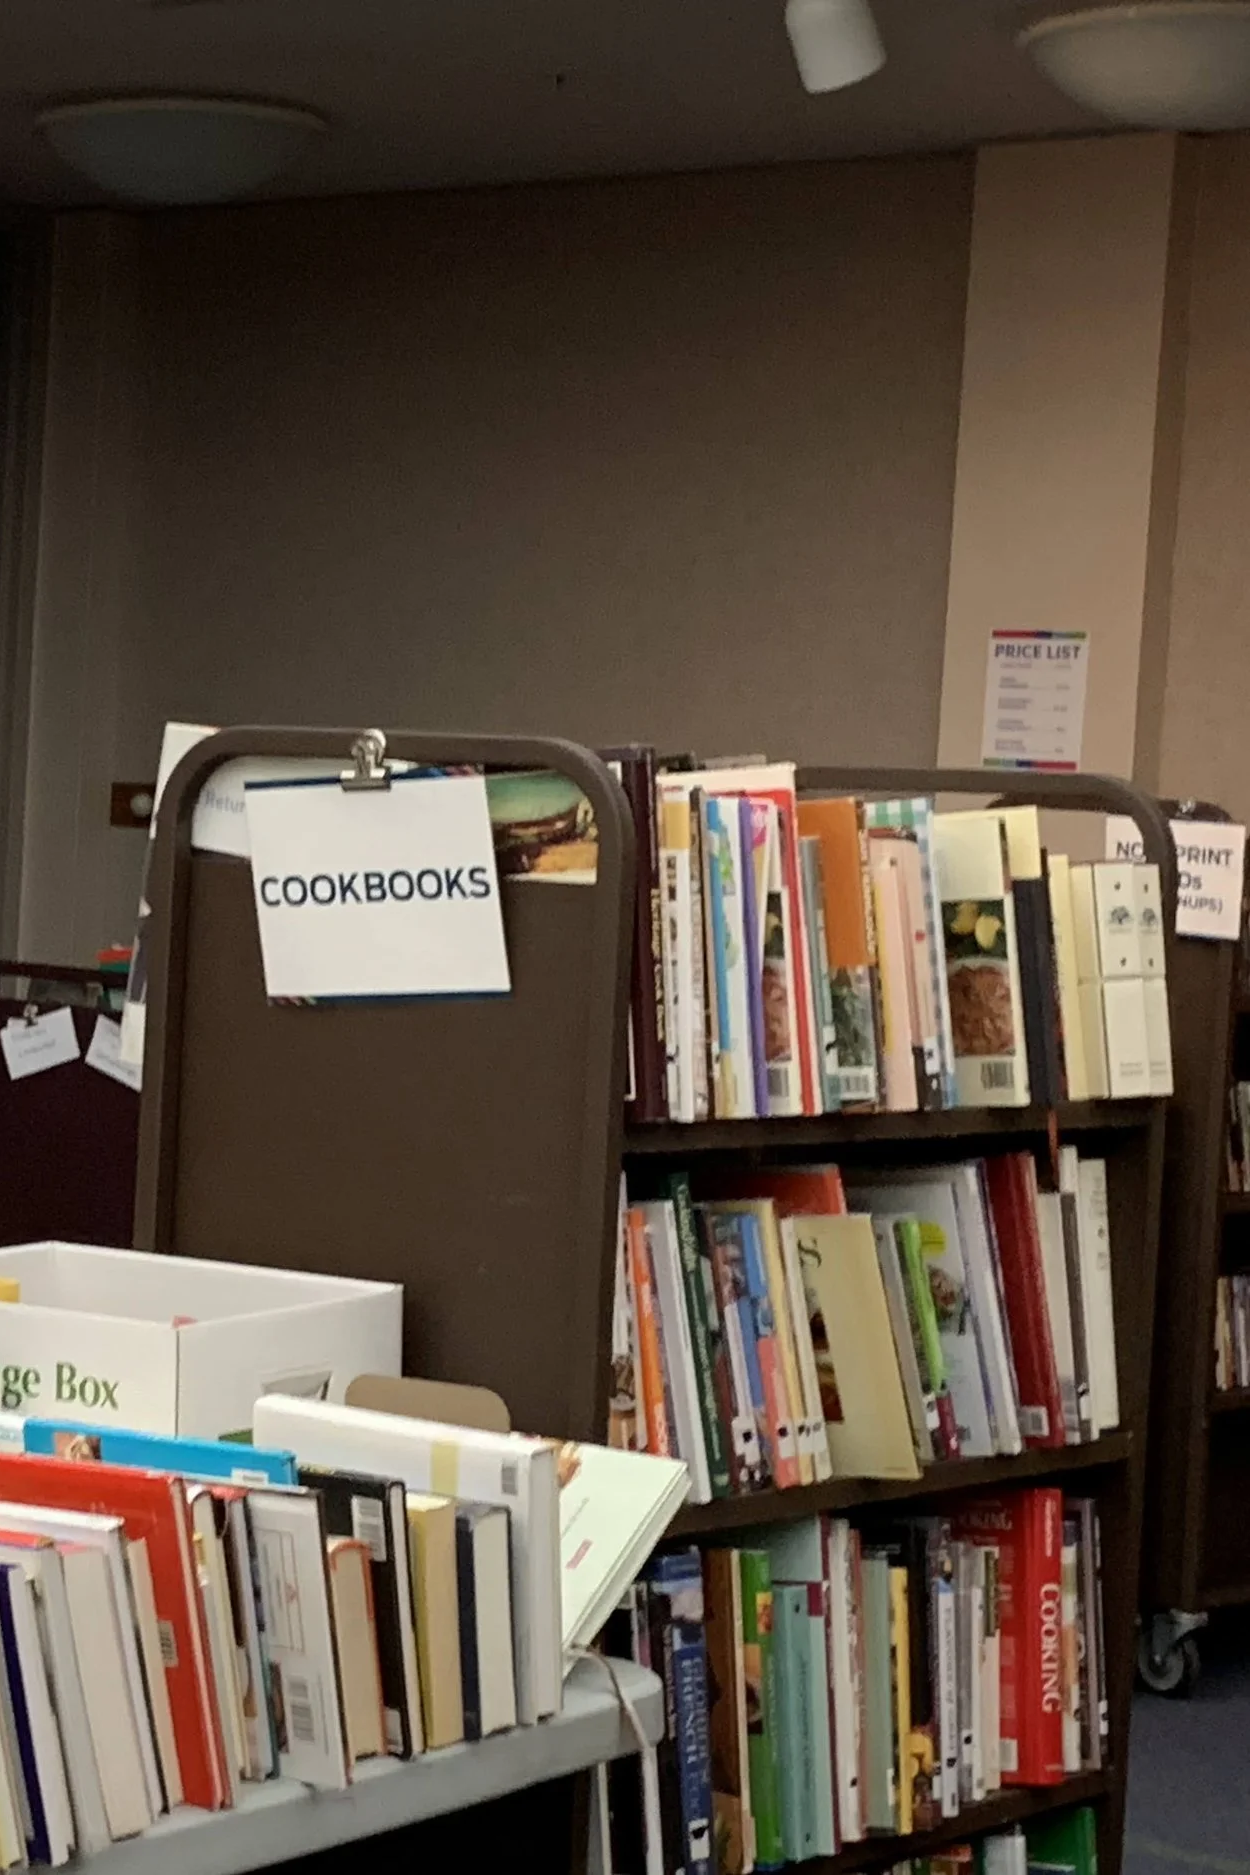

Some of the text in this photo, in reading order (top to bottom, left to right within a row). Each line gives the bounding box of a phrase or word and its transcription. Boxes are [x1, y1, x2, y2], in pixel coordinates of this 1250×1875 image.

[994, 643, 1081, 660] PRICE LIST
[260, 867, 491, 907] COOKBOOKS
[55, 1361, 119, 1411] Box
[1040, 1583, 1061, 1713] COOKING
